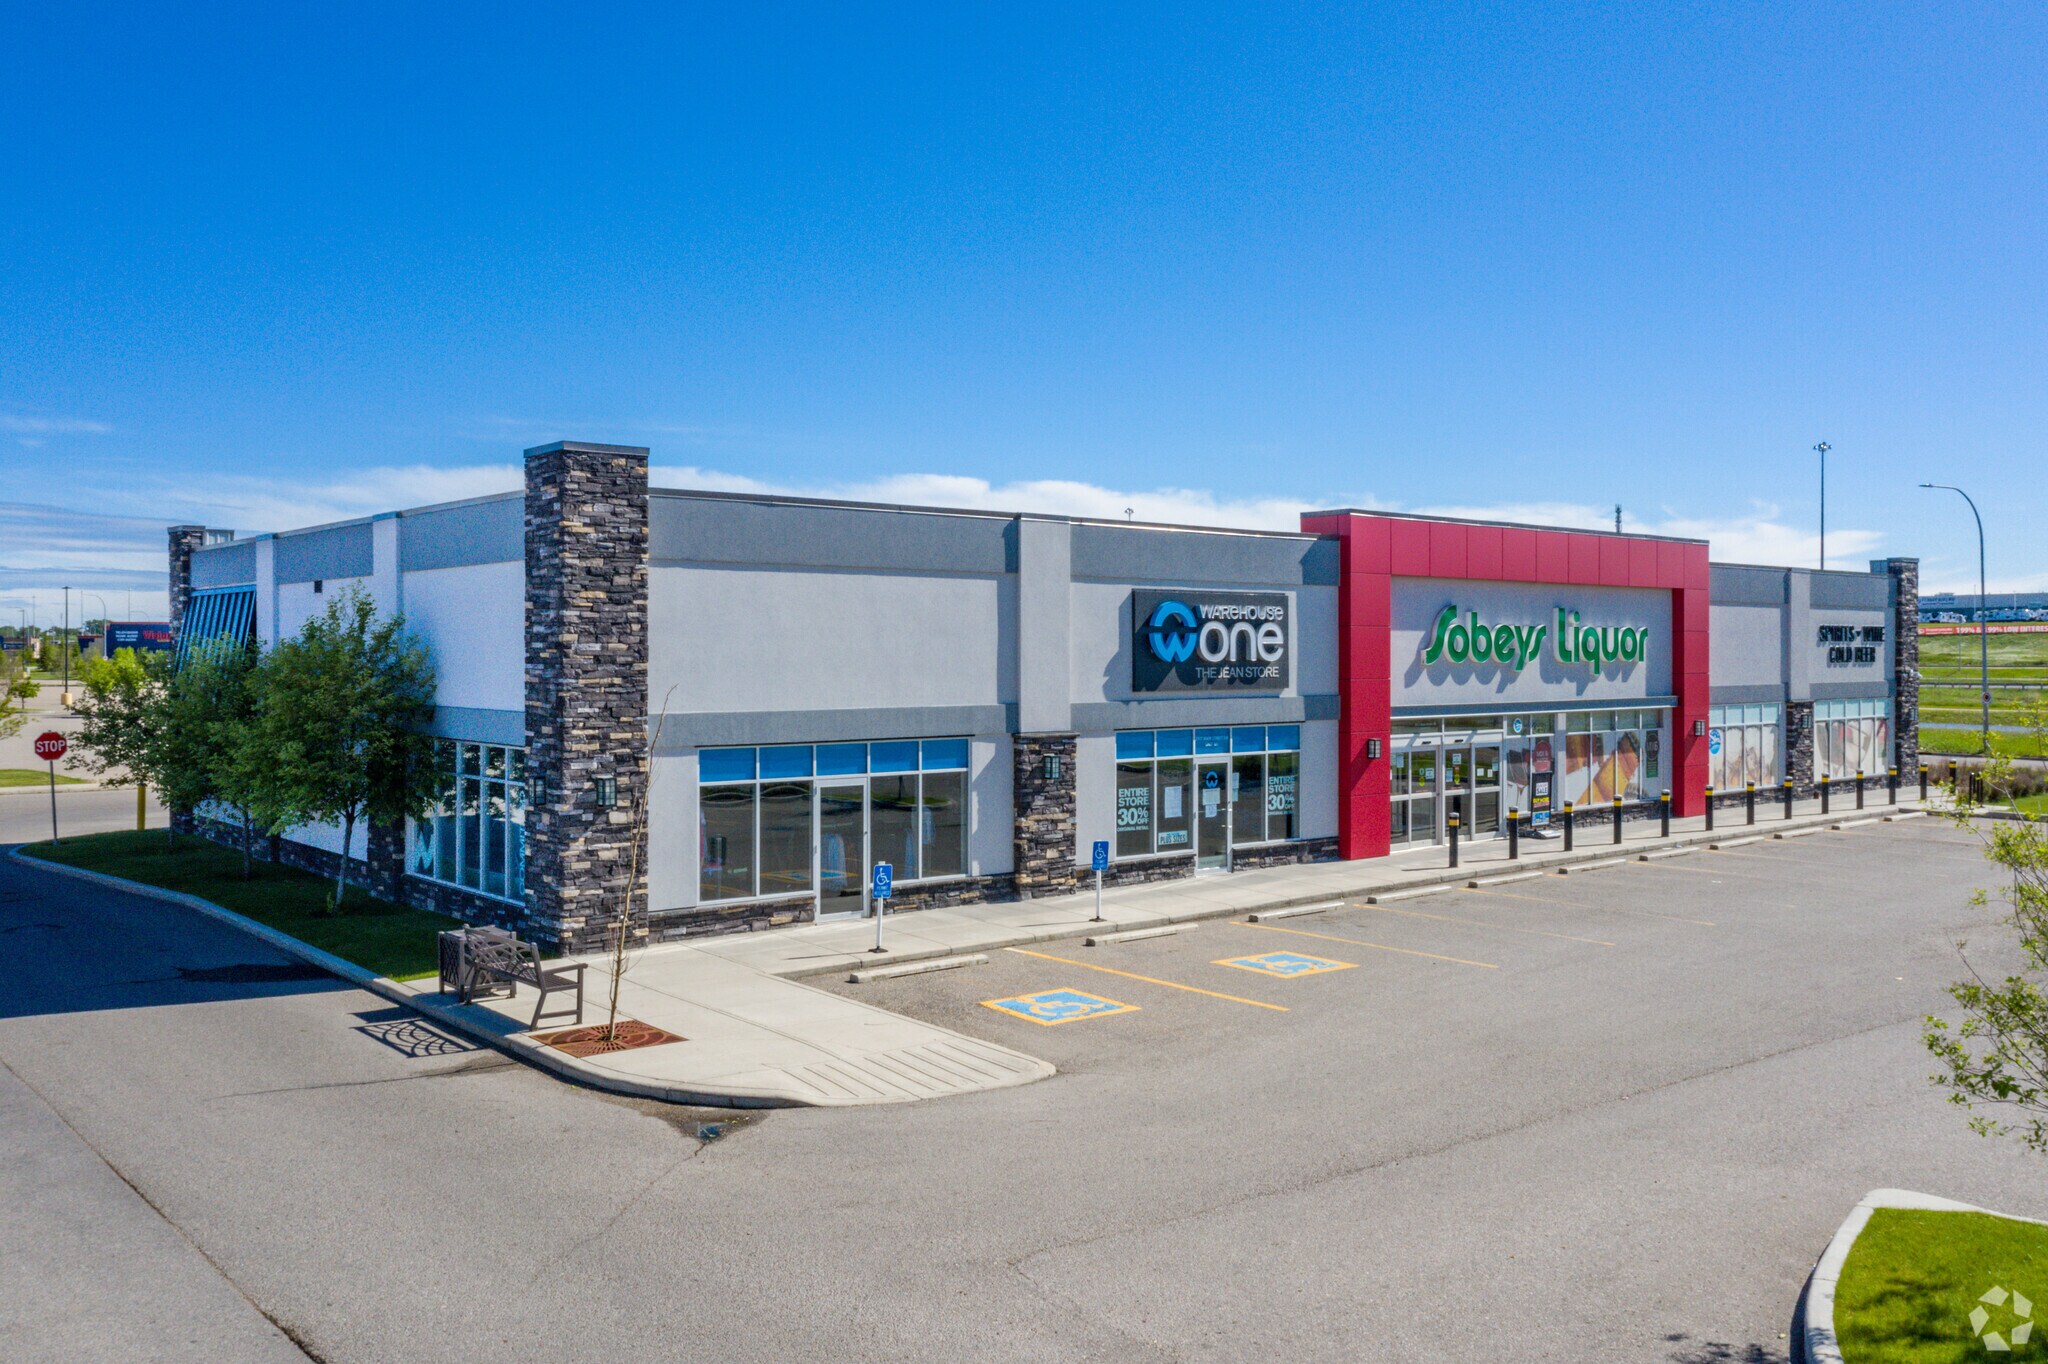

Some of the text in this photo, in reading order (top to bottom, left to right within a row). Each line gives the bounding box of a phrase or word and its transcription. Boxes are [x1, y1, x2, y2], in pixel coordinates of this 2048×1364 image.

[1420, 604, 1648, 675] Sobeys Liquor
[1819, 625, 1855, 642] SPIRITS
[1200, 621, 1284, 662] one
[1829, 646, 1876, 663] COLD BEER
[1195, 667, 1279, 678] THE JEAN STORE
[36, 740, 66, 752] STOP
[1269, 776, 1295, 784] ENTIRE
[1118, 788, 1149, 797] ENTIRE
[1269, 784, 1295, 793] STORE
[1118, 797, 1149, 807] STORE
[1118, 807, 1149, 826] 30%
